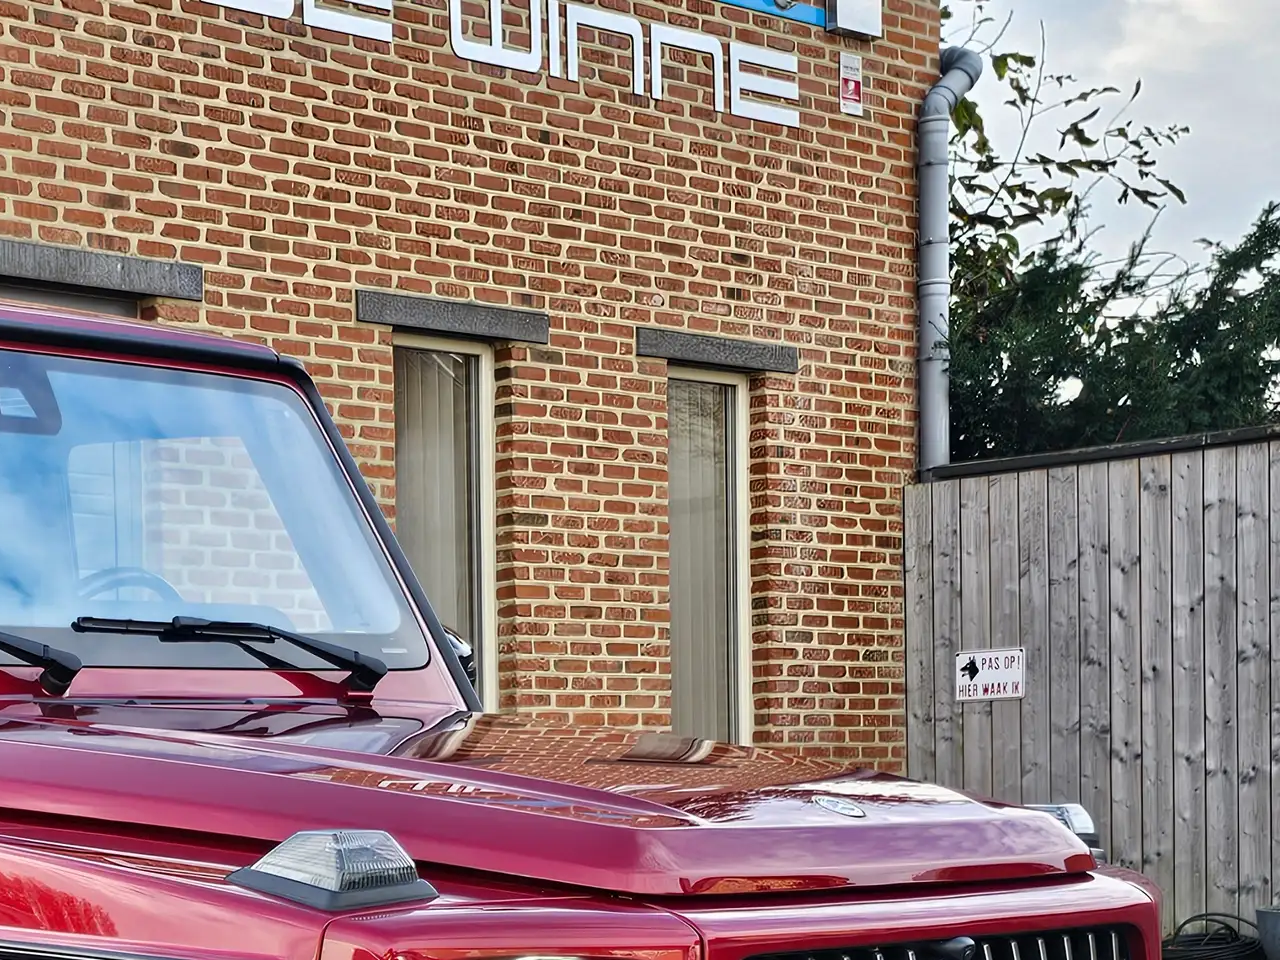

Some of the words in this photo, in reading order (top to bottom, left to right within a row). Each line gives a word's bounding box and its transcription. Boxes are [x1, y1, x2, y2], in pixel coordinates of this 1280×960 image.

[981, 656, 1000, 670] PAS
[1004, 655, 1020, 670] OP!
[958, 683, 978, 698] HIER
[982, 682, 1008, 697] WAAK
[1011, 681, 1020, 694] IK
